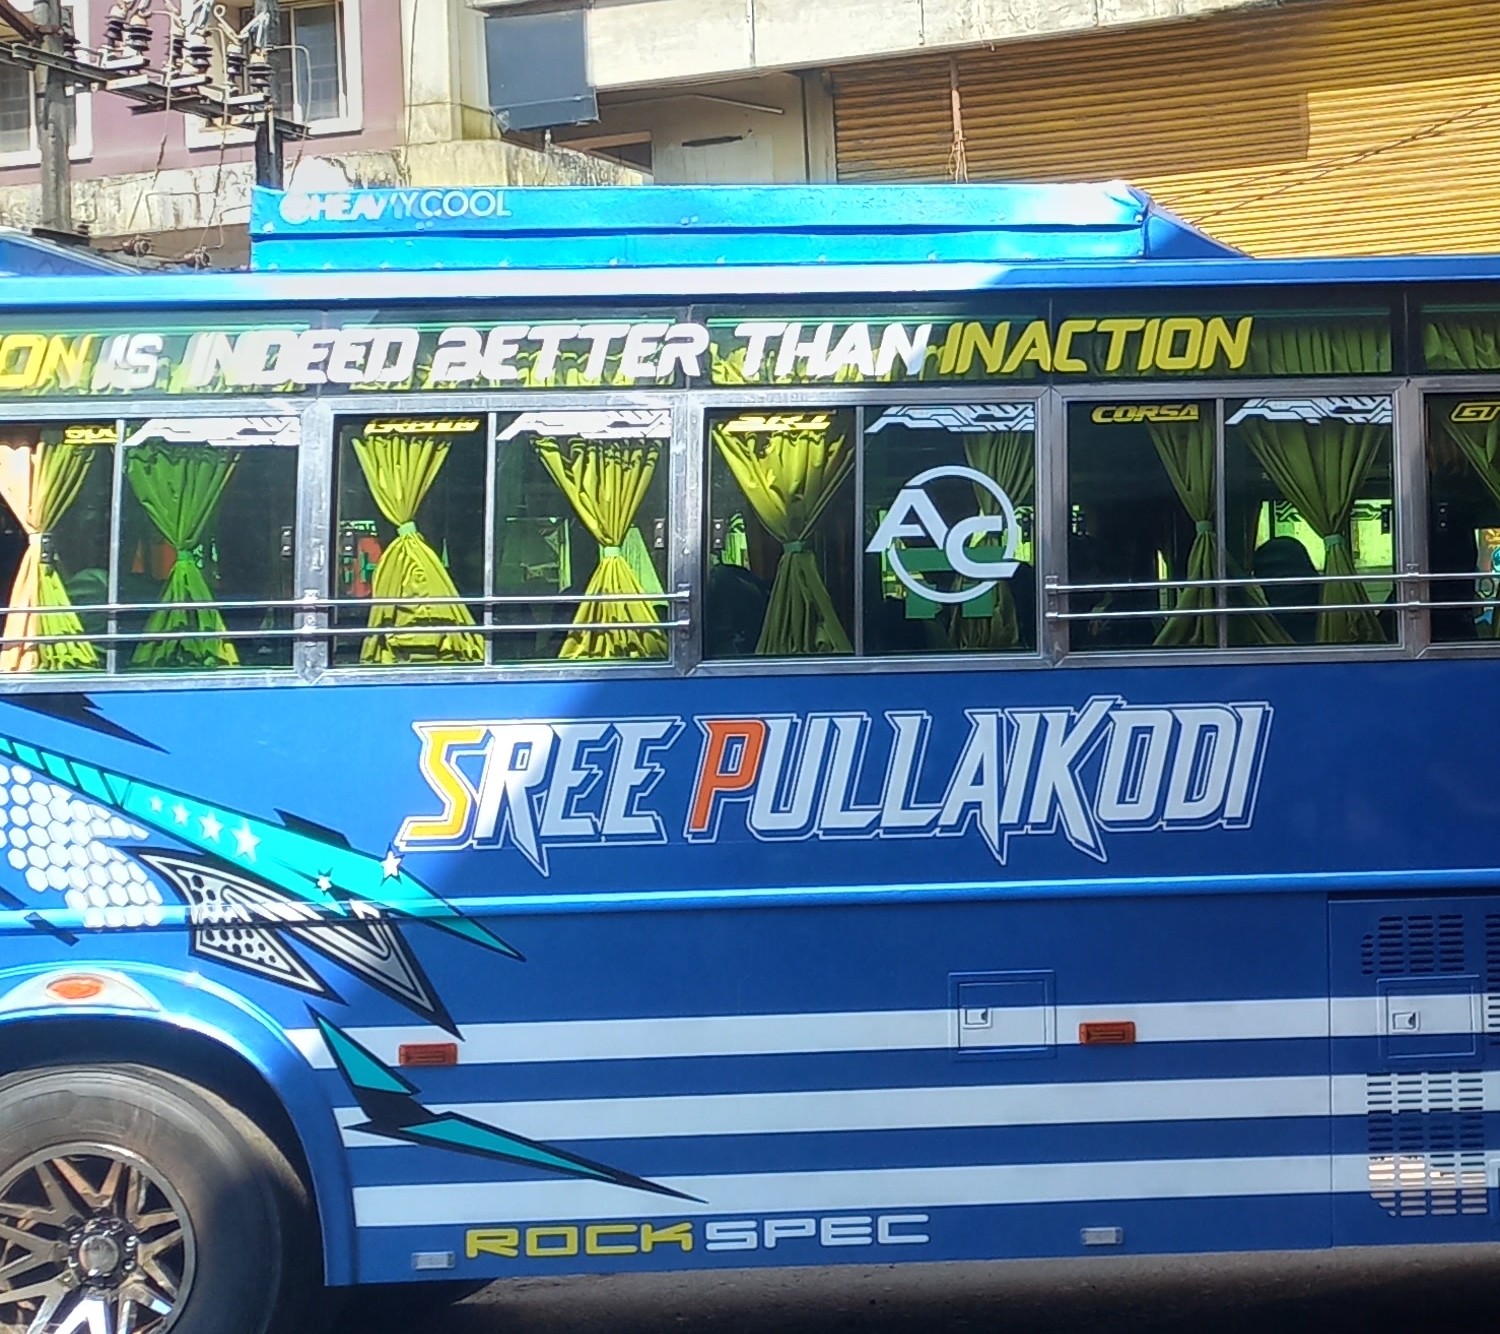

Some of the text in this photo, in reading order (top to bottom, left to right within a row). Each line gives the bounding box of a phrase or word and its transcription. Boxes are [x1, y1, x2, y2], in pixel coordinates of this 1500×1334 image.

[0, 316, 1253, 390] ON IS INDEED BETTER THAN INACTION
[1091, 403, 1199, 423] CORSA
[398, 695, 1273, 877] SREE PULLAIKODI
